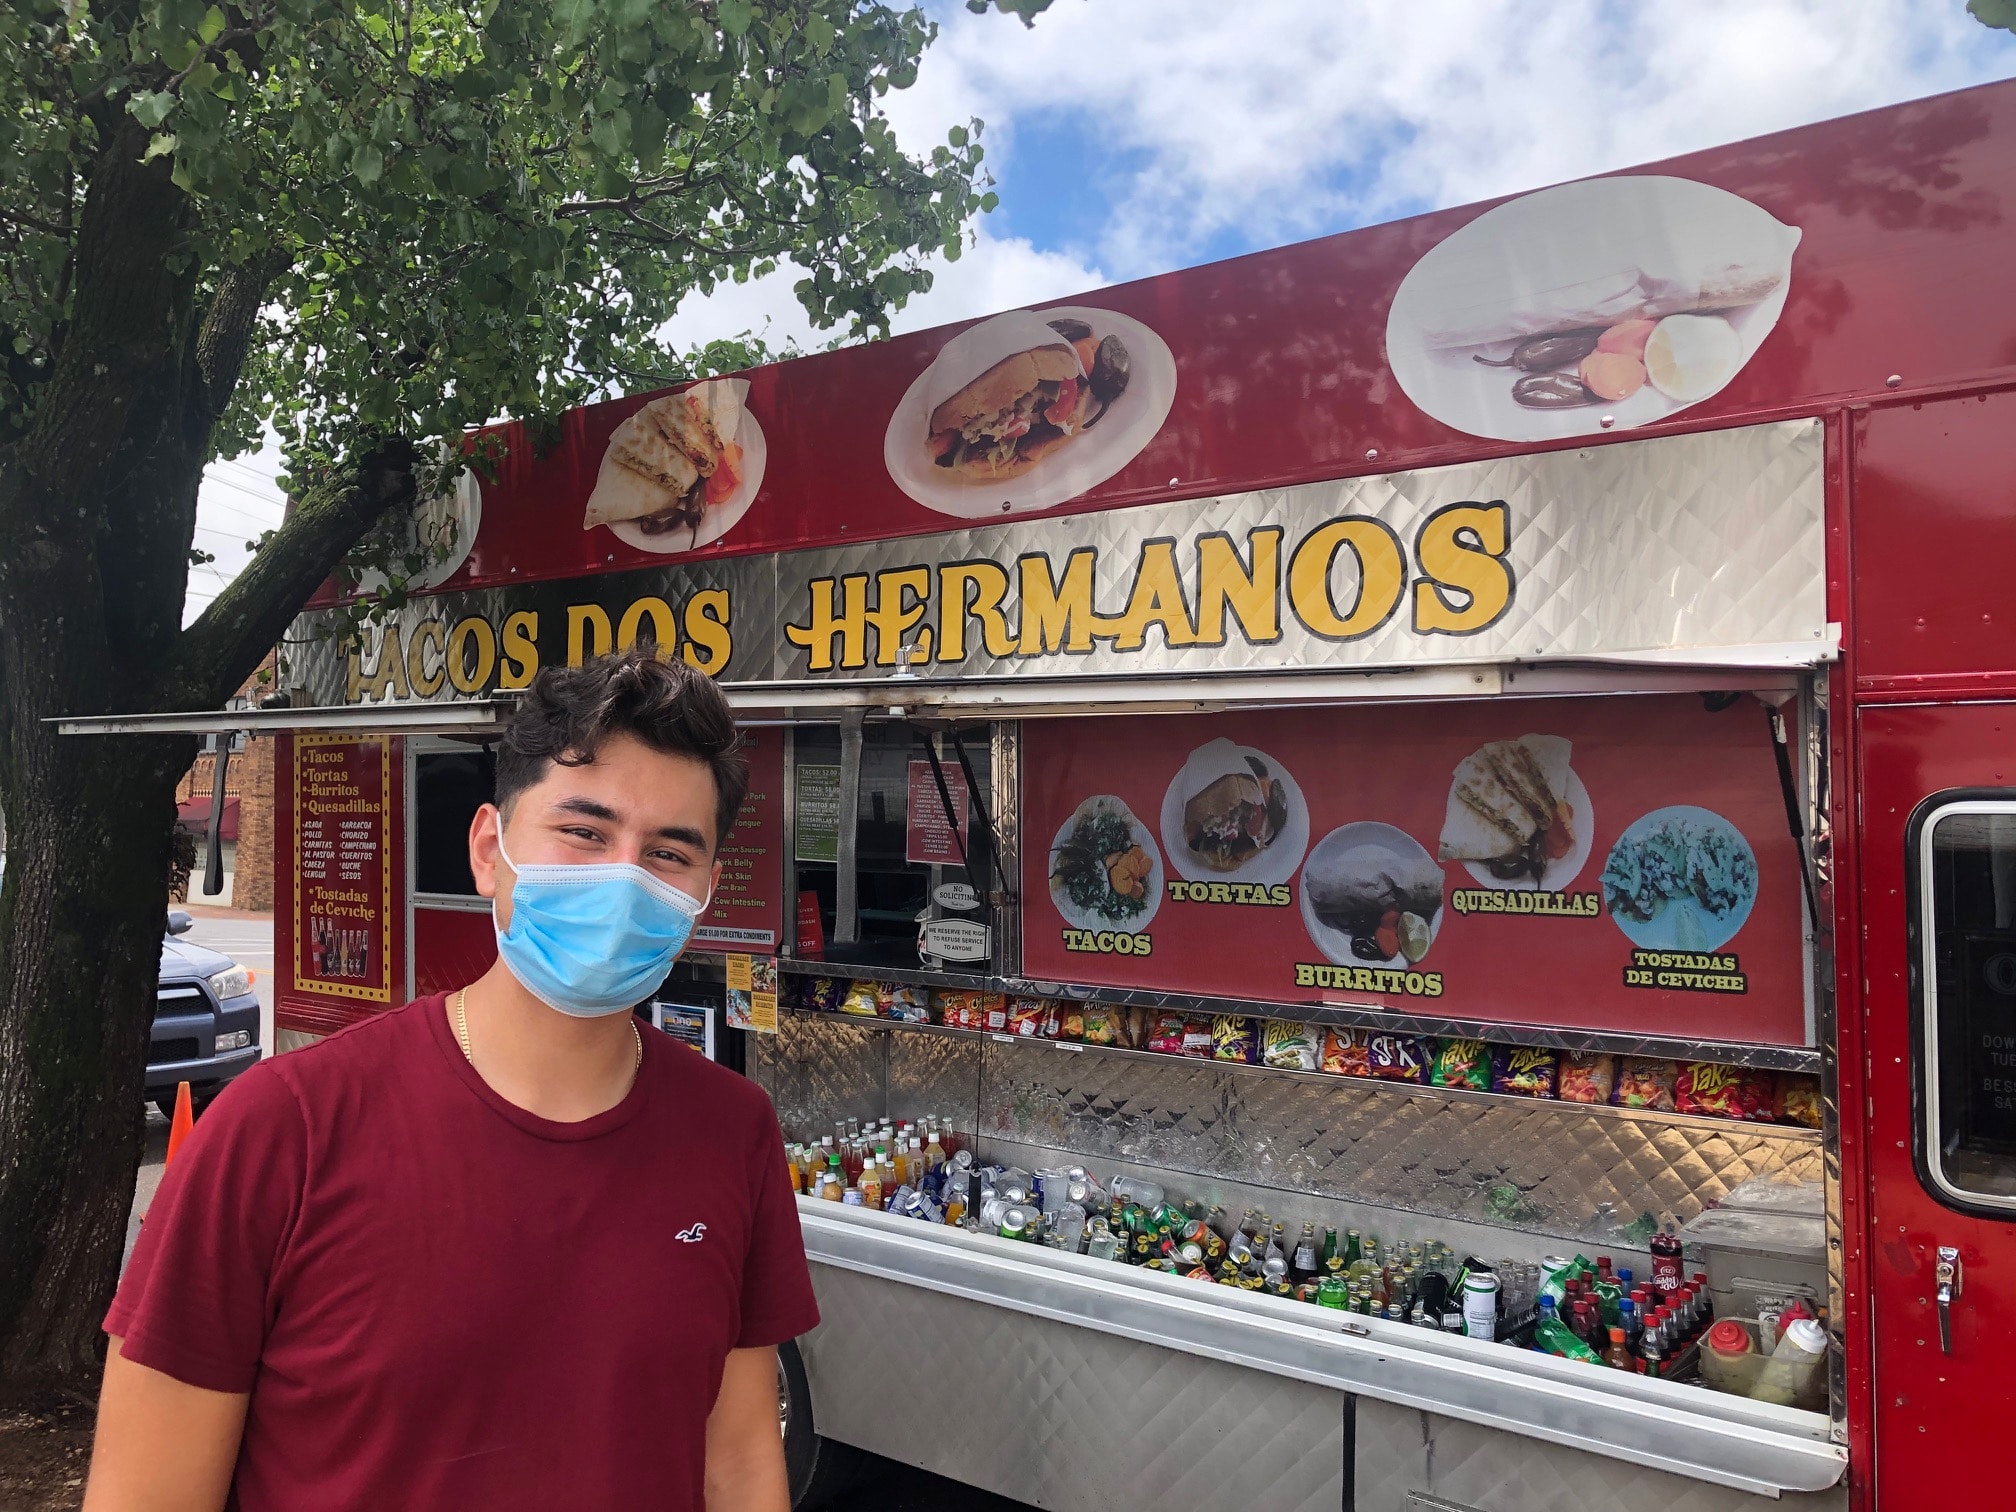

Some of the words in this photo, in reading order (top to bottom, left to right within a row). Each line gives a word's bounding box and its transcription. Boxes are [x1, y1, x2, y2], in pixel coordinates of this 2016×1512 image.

[336, 610, 540, 704] TACOS
[566, 589, 732, 680] DOS
[783, 500, 1514, 672] HERMANOS
[308, 749, 344, 763] Tacos
[307, 768, 349, 782] Tortas
[307, 783, 360, 796] Burritos
[749, 793, 766, 801] Pork
[308, 799, 380, 815] Quesadillas
[304, 821, 323, 830] ASADA
[341, 821, 372, 830] BARBACOA
[735, 819, 761, 828] Tongue
[304, 830, 323, 839] POLLO
[341, 831, 369, 840] CHORIZO
[304, 841, 333, 849] CARNITAS
[341, 841, 377, 850] CAMPECHANO
[304, 851, 311, 859] AL
[312, 851, 335, 859] PASTOR
[739, 846, 766, 855] Sausage
[341, 851, 373, 860] CUERITOS
[304, 861, 326, 869] CABEZA
[341, 861, 362, 870] BUCHE
[734, 859, 753, 869] Belly
[304, 871, 327, 879] LENGUA
[720, 872, 734, 880] ork
[735, 872, 752, 880] Skin
[953, 885, 964, 893] NO
[1168, 881, 1291, 906] TORTAS
[314, 886, 369, 903] Tostadas
[939, 892, 973, 901] SOLICITIN
[732, 898, 766, 907] Intestine
[1451, 889, 1600, 917] QUESADILLAS
[309, 901, 324, 914] de
[325, 902, 376, 921] Ceviche
[720, 930, 729, 938] FOR
[729, 931, 743, 939] EXTRA
[937, 928, 960, 936] RESERVE
[1062, 929, 1152, 956] TACOS
[1634, 951, 1736, 972] TOSTADAS
[1295, 963, 1443, 996] BURRITOS
[1625, 970, 1655, 985] DE
[1659, 972, 1745, 991] CEVICHE
[1654, 1276, 1678, 1289] Pepper
